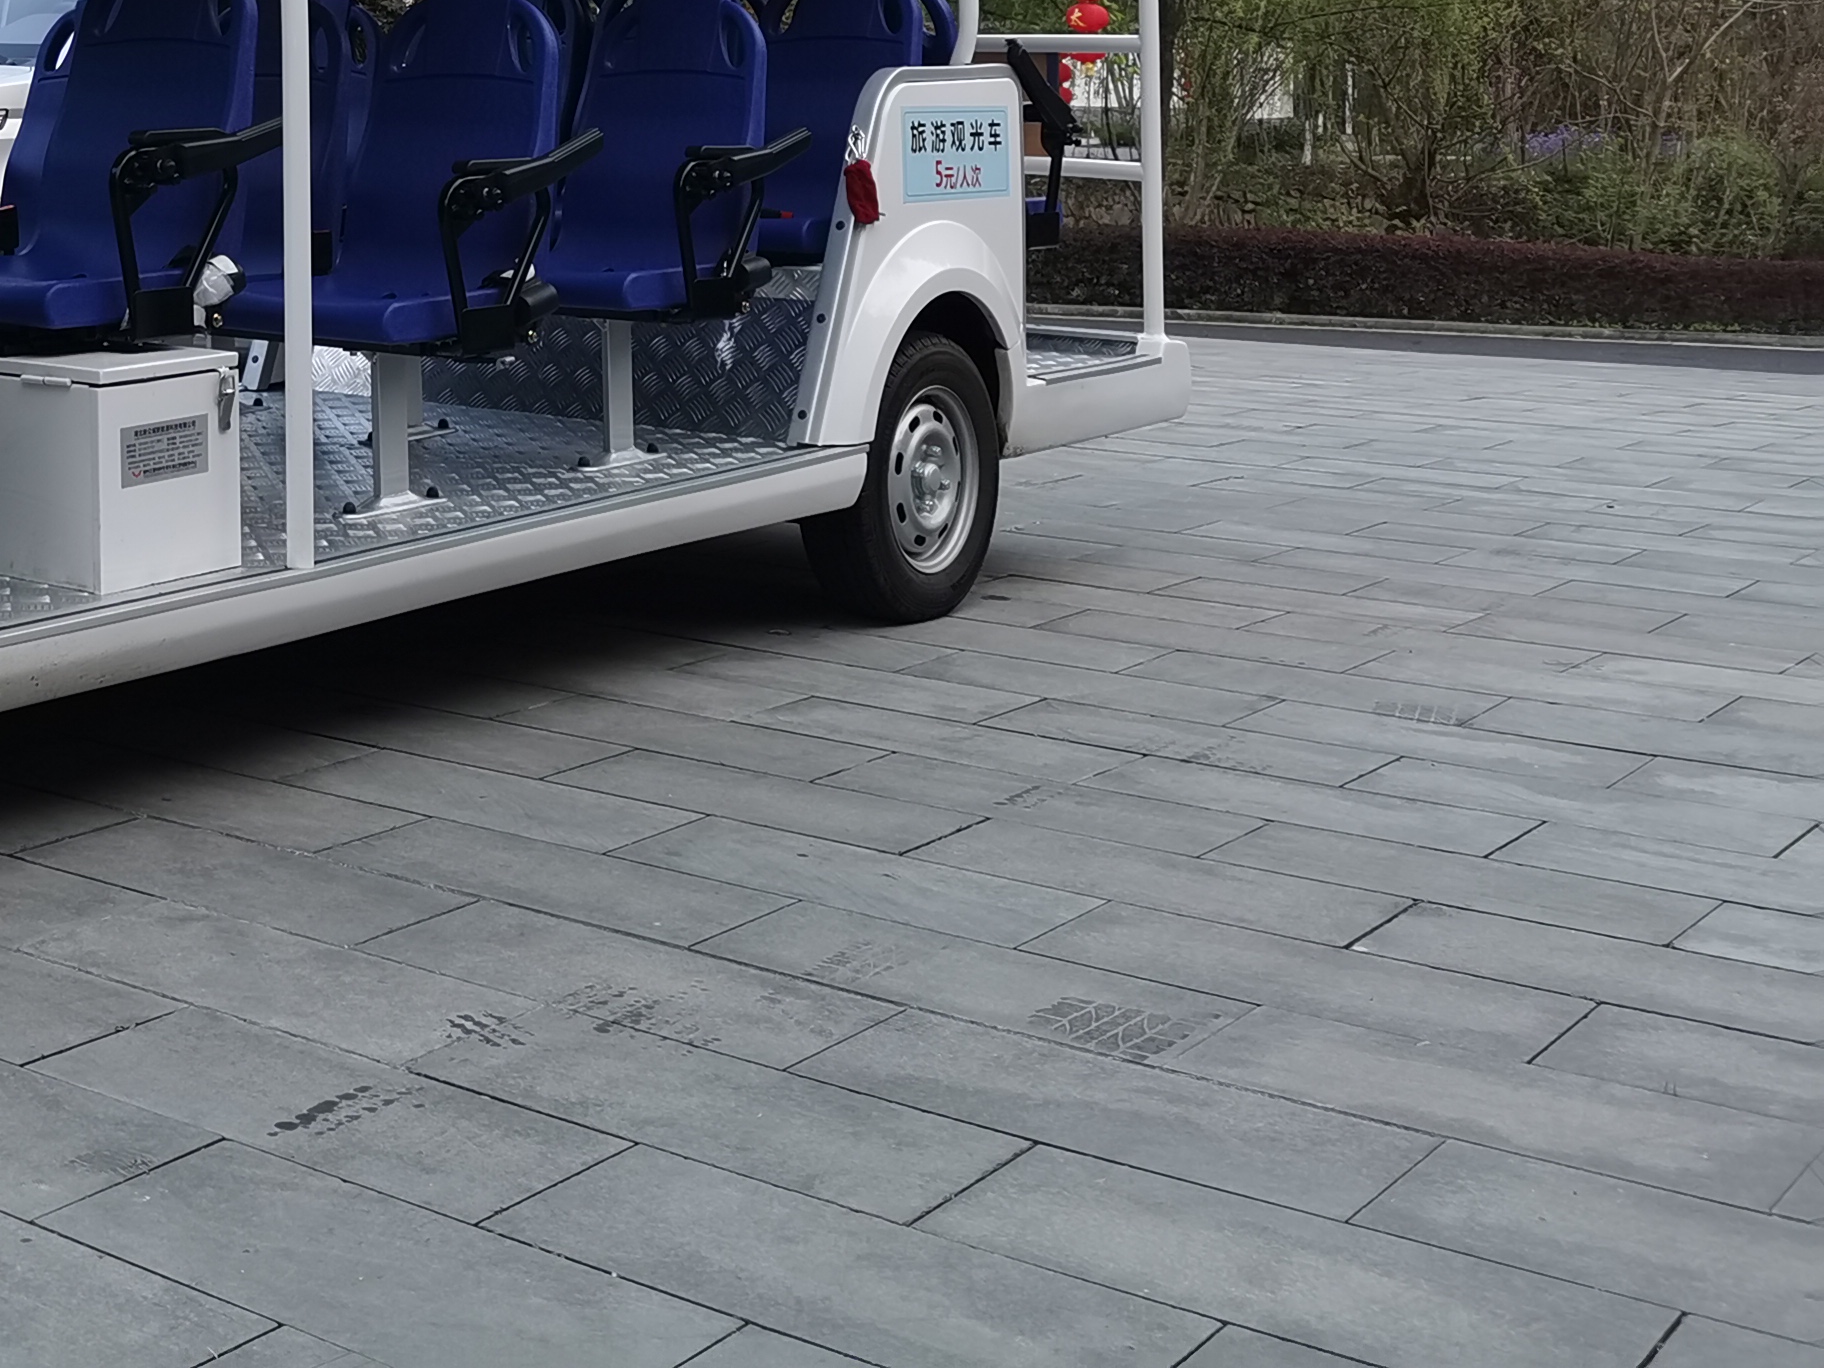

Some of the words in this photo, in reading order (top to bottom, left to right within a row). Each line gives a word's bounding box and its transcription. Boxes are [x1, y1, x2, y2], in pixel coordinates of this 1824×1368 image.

[910, 119, 1002, 154] 旅游观光车
[935, 160, 982, 190] 5元/人次
